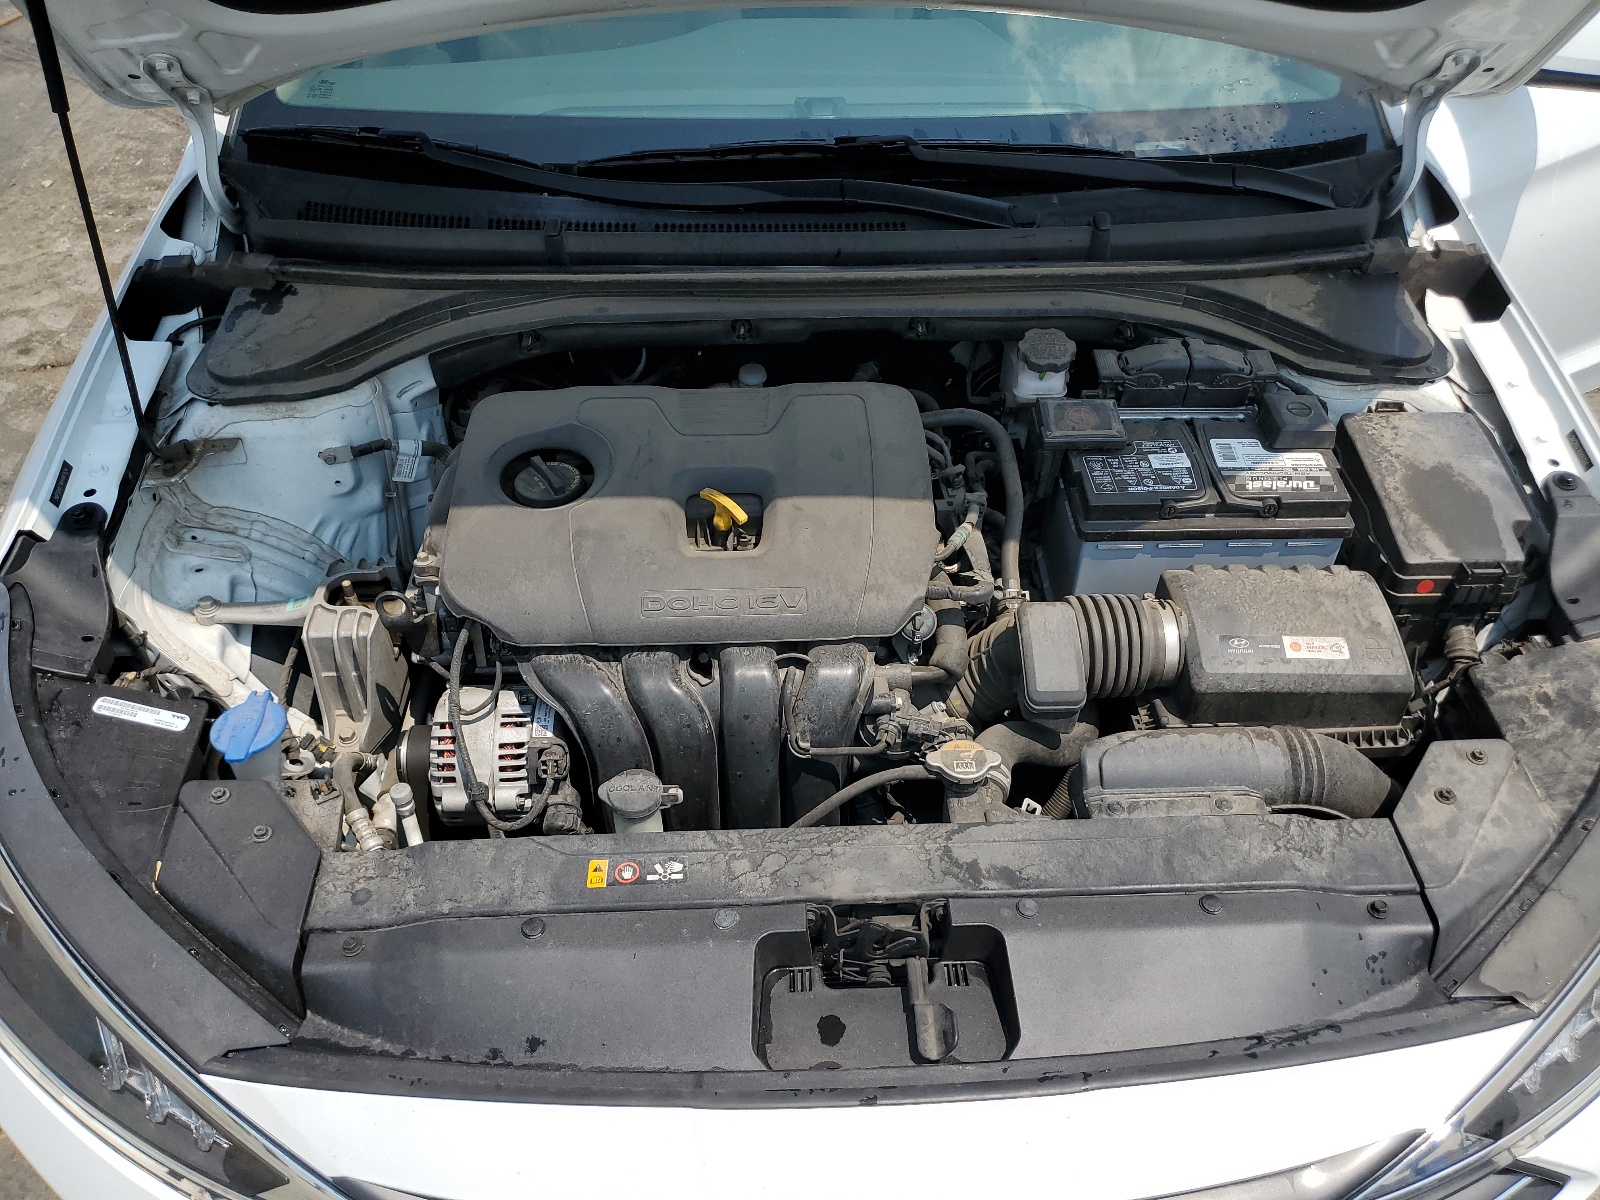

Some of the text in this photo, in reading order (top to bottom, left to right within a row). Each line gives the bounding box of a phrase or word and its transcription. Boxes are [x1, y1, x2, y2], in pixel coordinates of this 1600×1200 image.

[1245, 480, 1320, 491] Duralast
[643, 593, 804, 612] DOHC 16V
[608, 784, 661, 793] COOLANT
